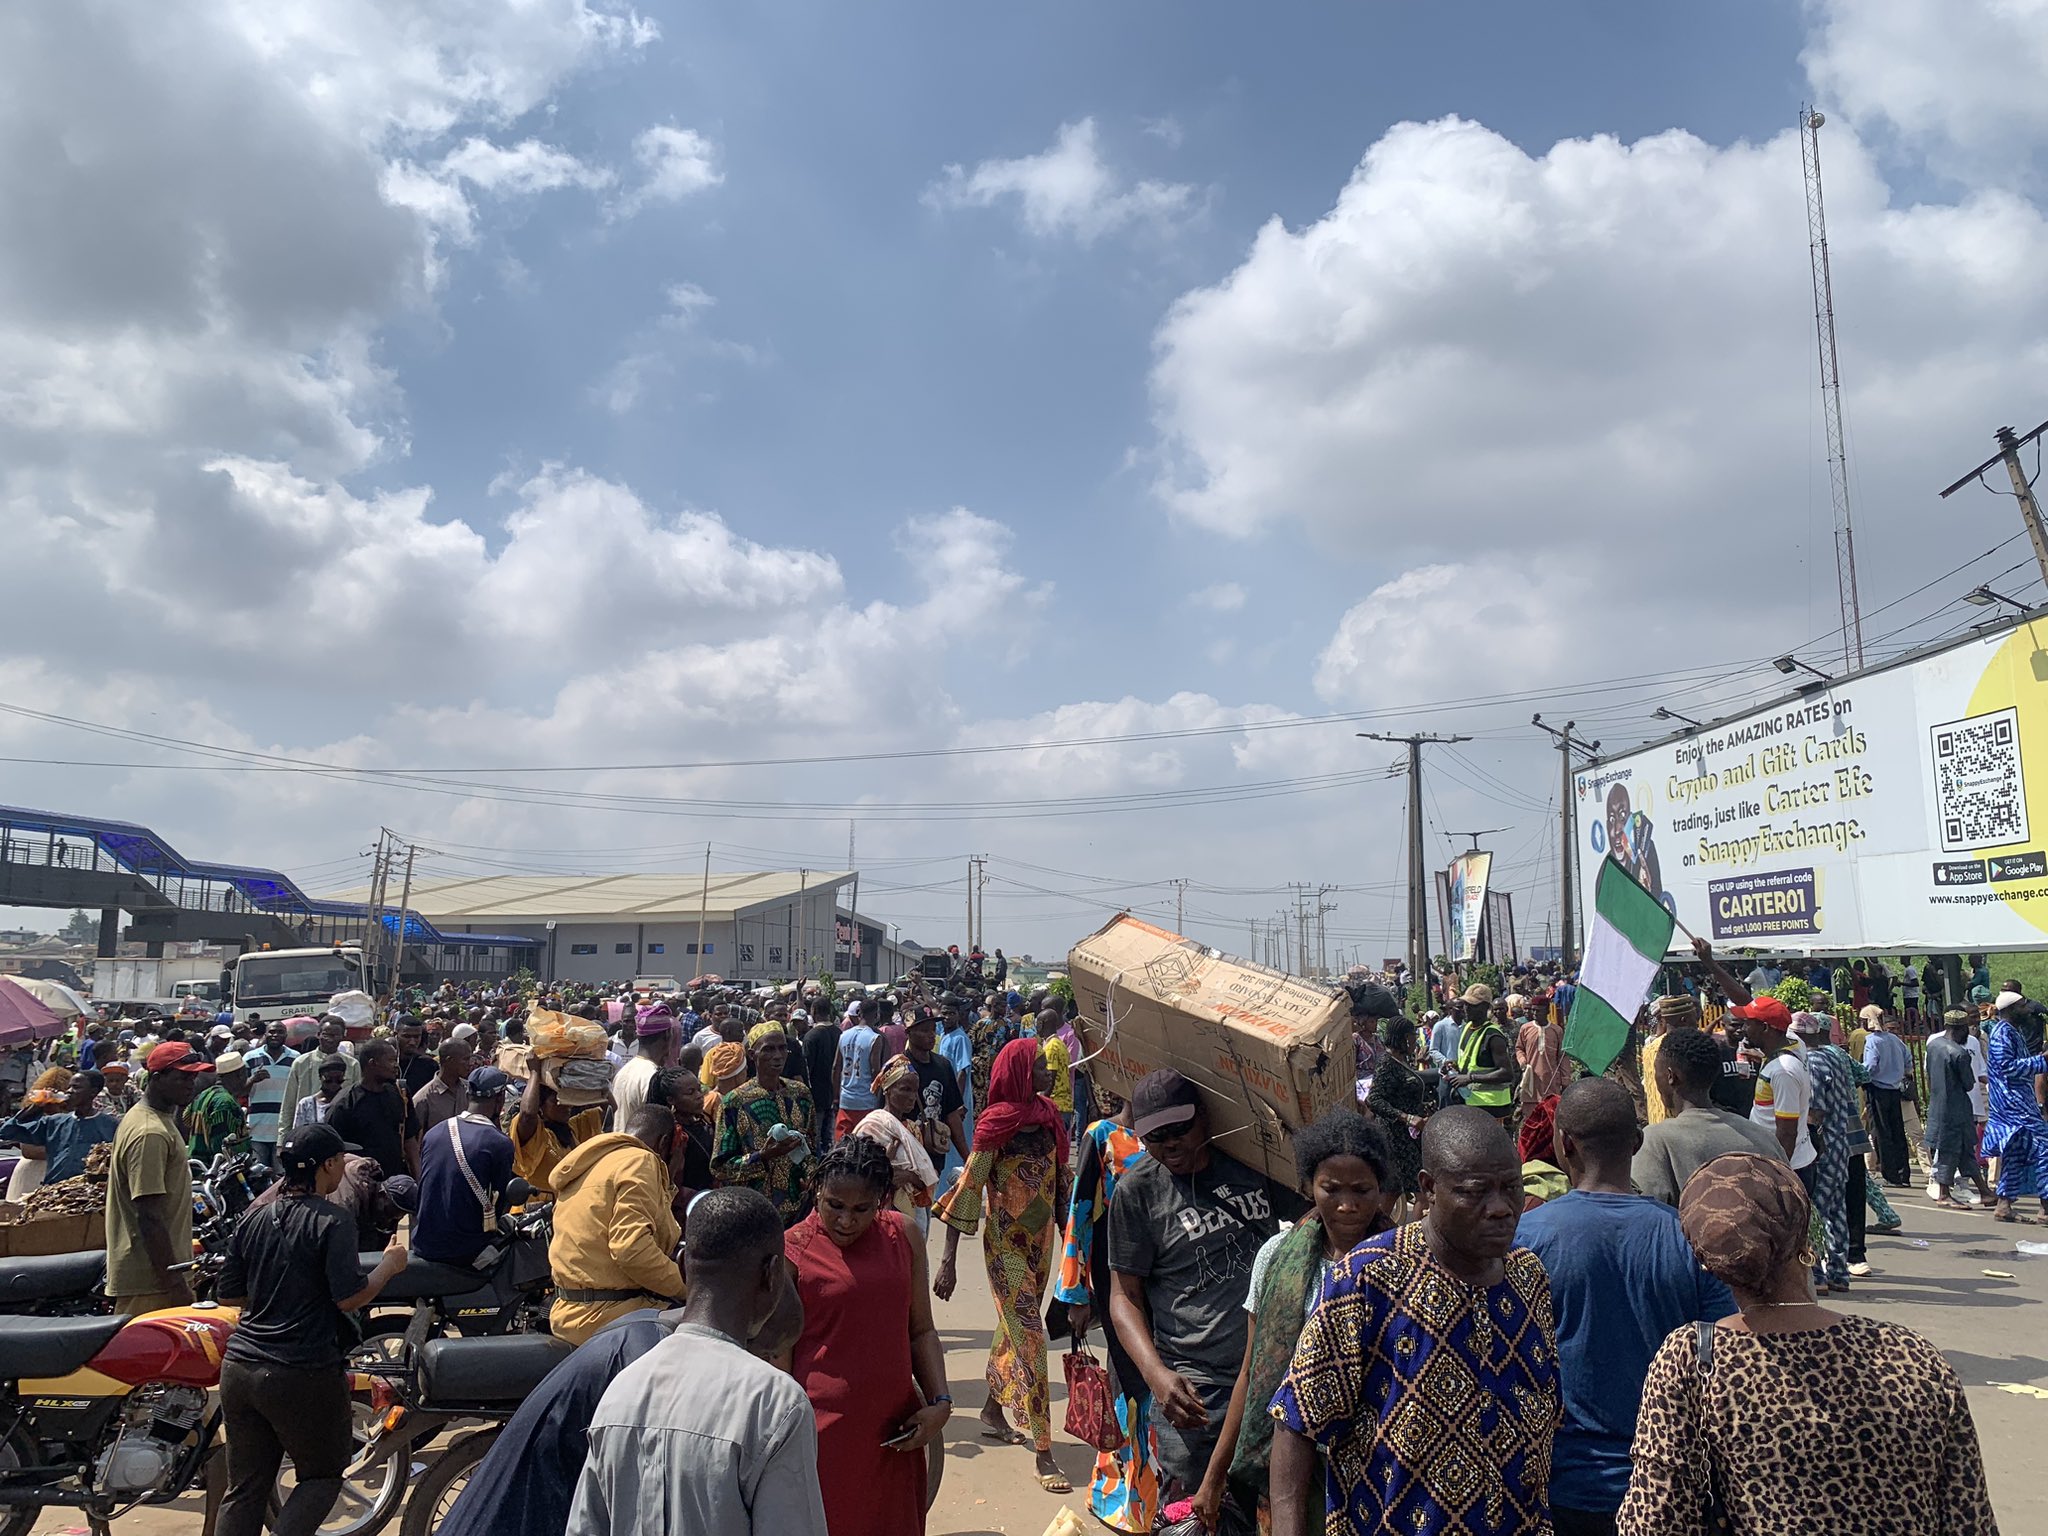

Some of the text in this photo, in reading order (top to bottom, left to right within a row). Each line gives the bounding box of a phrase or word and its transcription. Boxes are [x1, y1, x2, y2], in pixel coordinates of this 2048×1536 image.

[1675, 698, 1852, 766] Enjoy the AMAZING RATES on
[1666, 725, 1867, 805] Crypto and Gift Cards
[1588, 768, 1632, 789] SnappyExchange
[1673, 764, 1874, 833] trading, just like Carter Efe
[1682, 853, 1696, 867] on
[1949, 871, 1983, 883] App Store
[2005, 862, 2044, 876] Google Play
[1710, 871, 1813, 893] SIGN UP using the referral code
[1719, 888, 1806, 919] CARTER01
[1720, 918, 1809, 936] and get 1,000 FREE POINTS
[1239, 973, 1256, 984] 304
[1280, 984, 1321, 1007] Stainless
[1283, 1001, 1312, 1017] ITALY
[1212, 1184, 1232, 1200] THE
[185, 1323, 211, 1332] TVS
[34, 1398, 74, 1407] HLX
